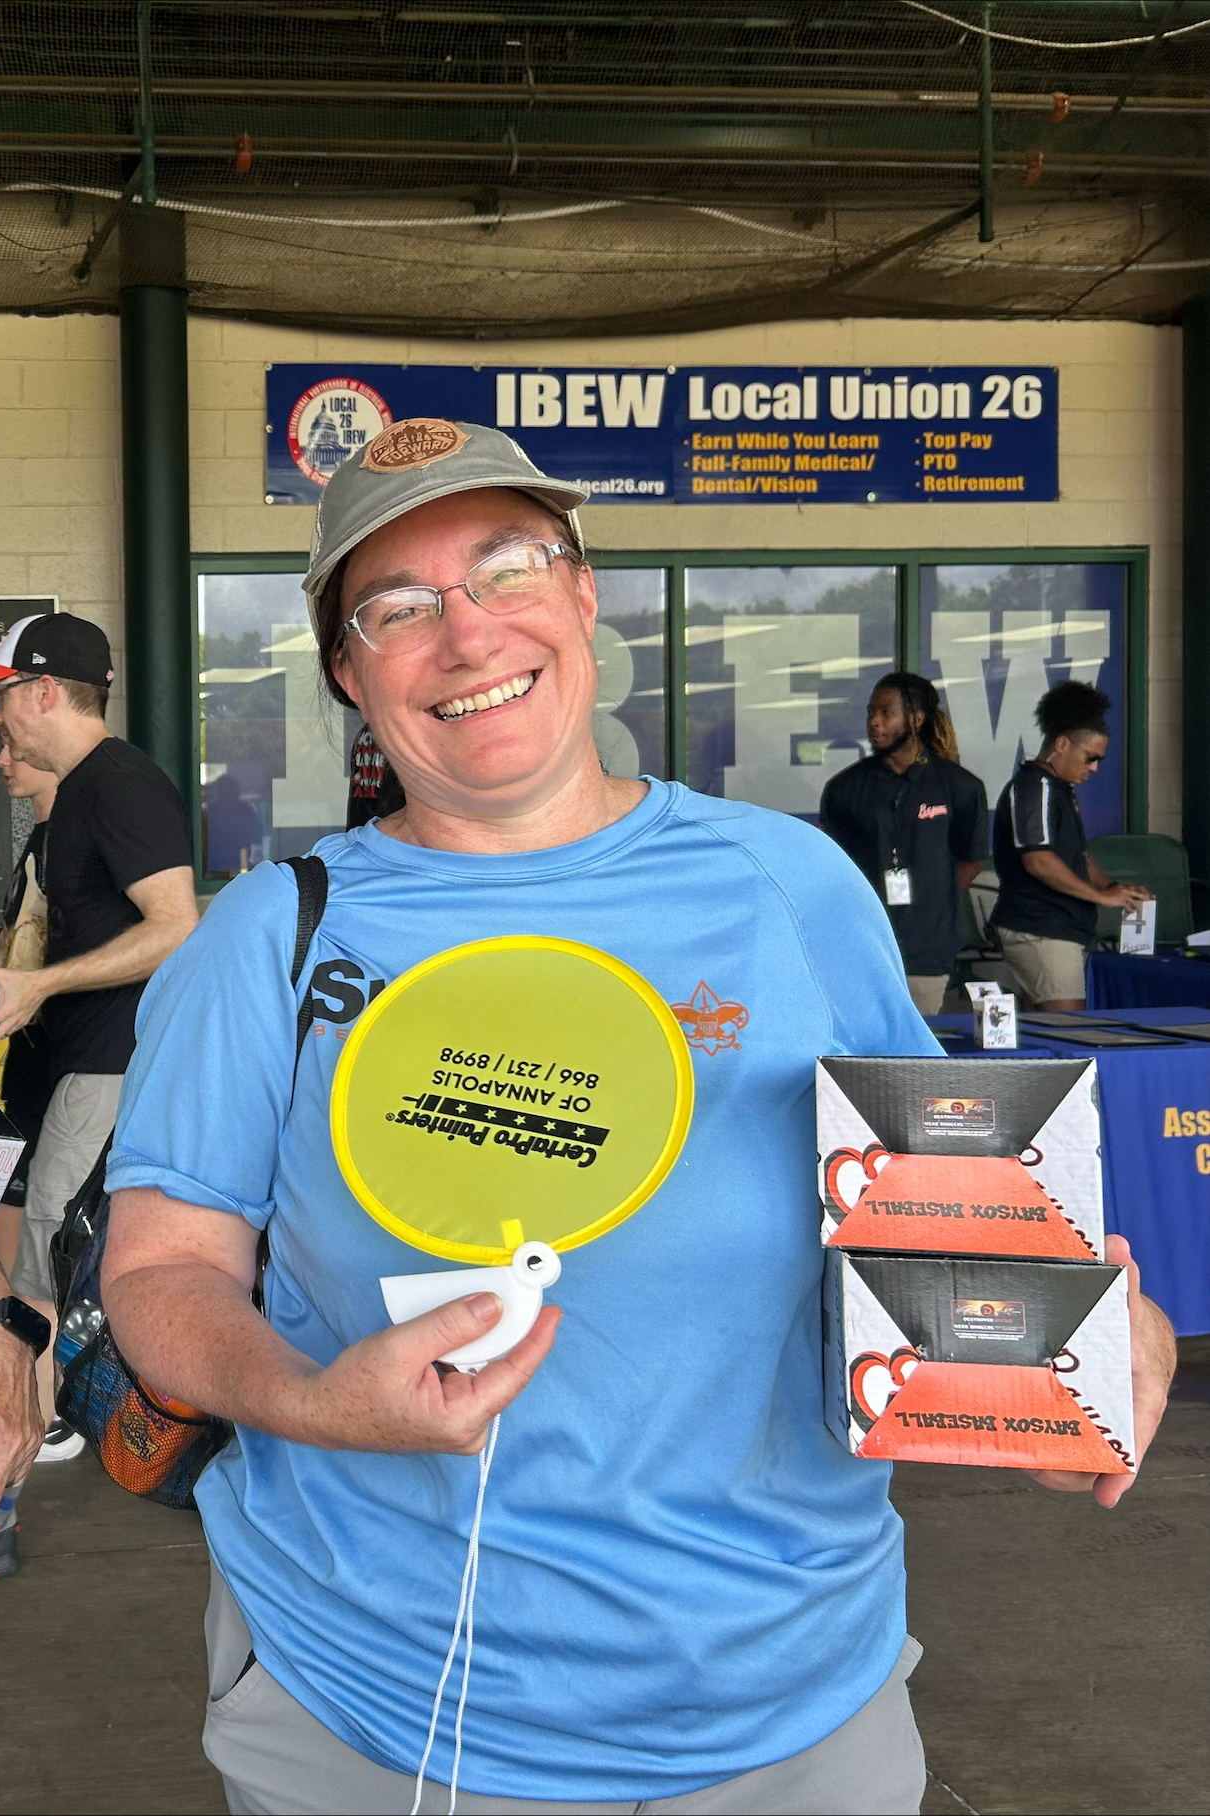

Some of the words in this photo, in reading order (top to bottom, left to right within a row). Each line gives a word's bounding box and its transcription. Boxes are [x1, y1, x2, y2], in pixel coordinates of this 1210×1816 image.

[330, 397, 357, 412] LOCAL
[496, 373, 665, 428] IBEW
[689, 376, 817, 420] Local
[830, 376, 970, 420] Union
[982, 375, 1042, 420] 26
[340, 414, 352, 428] 26
[343, 430, 366, 444] IBEW
[692, 433, 732, 450] Earn
[736, 432, 790, 450] While
[793, 432, 825, 449] You
[829, 432, 880, 449] Learn
[923, 432, 956, 450] Top
[960, 432, 993, 450] Pay
[692, 455, 791, 472] Full-Family
[794, 454, 875, 471] Medical/
[923, 454, 957, 470] PTO
[692, 476, 818, 493] Dental/Vision
[923, 475, 1025, 491] Retirement
[440, 1047, 490, 1069] 8998
[507, 1059, 542, 1079] 231
[560, 1068, 600, 1089] 866
[431, 1070, 556, 1106] ANNAPOLIS
[559, 1094, 591, 1113] OF
[493, 1129, 597, 1168] CertaPro
[865, 1200, 964, 1219] BASEBALL
[970, 1204, 1048, 1222] BAYSOX
[895, 1412, 997, 1431] BASEBALL
[1003, 1416, 1081, 1436] BAYSOX
